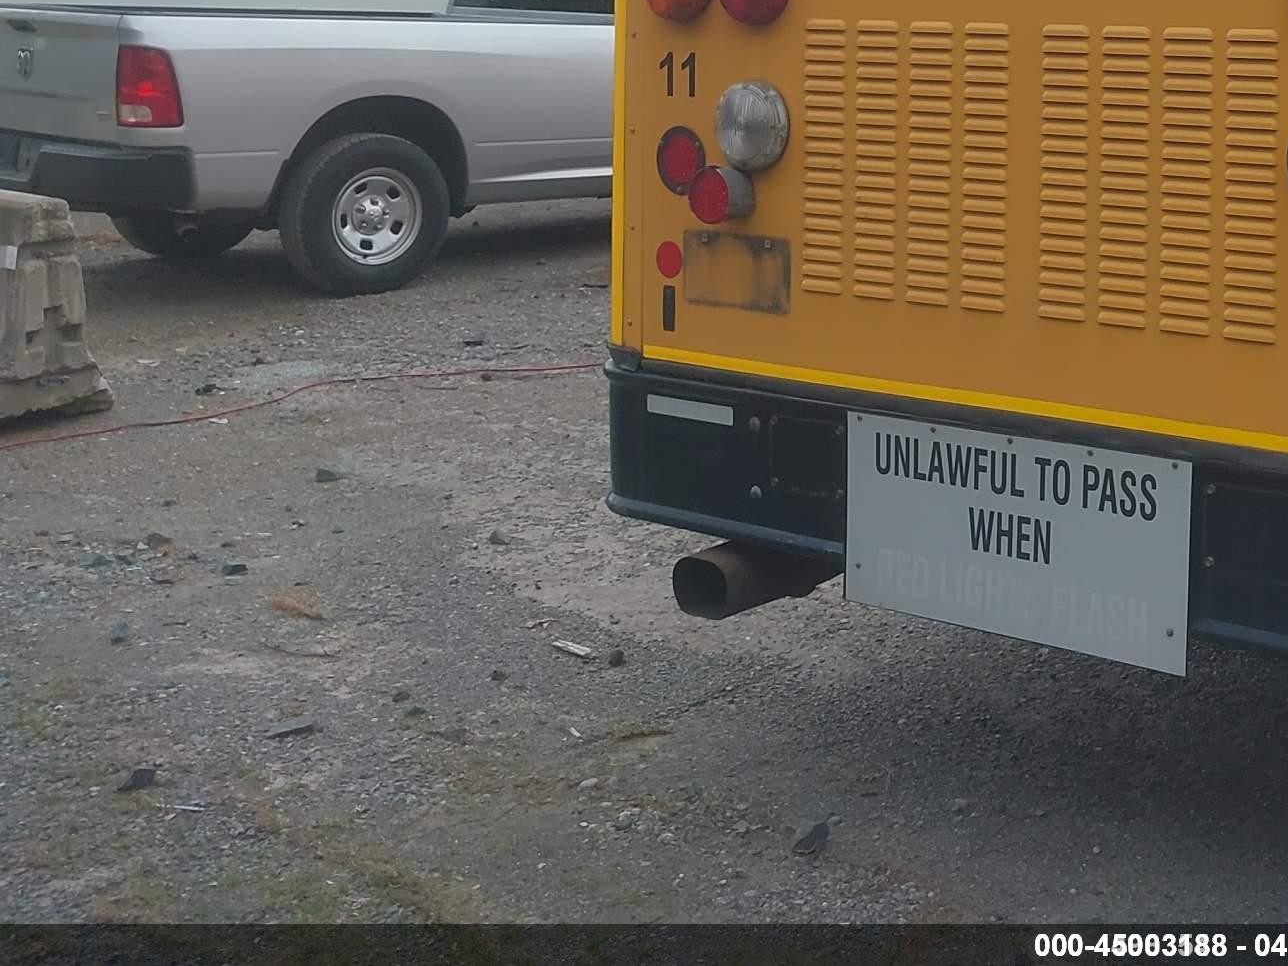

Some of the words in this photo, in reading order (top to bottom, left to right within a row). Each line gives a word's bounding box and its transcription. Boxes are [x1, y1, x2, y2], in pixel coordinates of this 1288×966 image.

[659, 51, 696, 98] 11
[875, 431, 1025, 498] UNLAWFUL
[1034, 455, 1071, 506] TO
[1082, 462, 1158, 522] PASS
[968, 505, 1051, 565] WHEN
